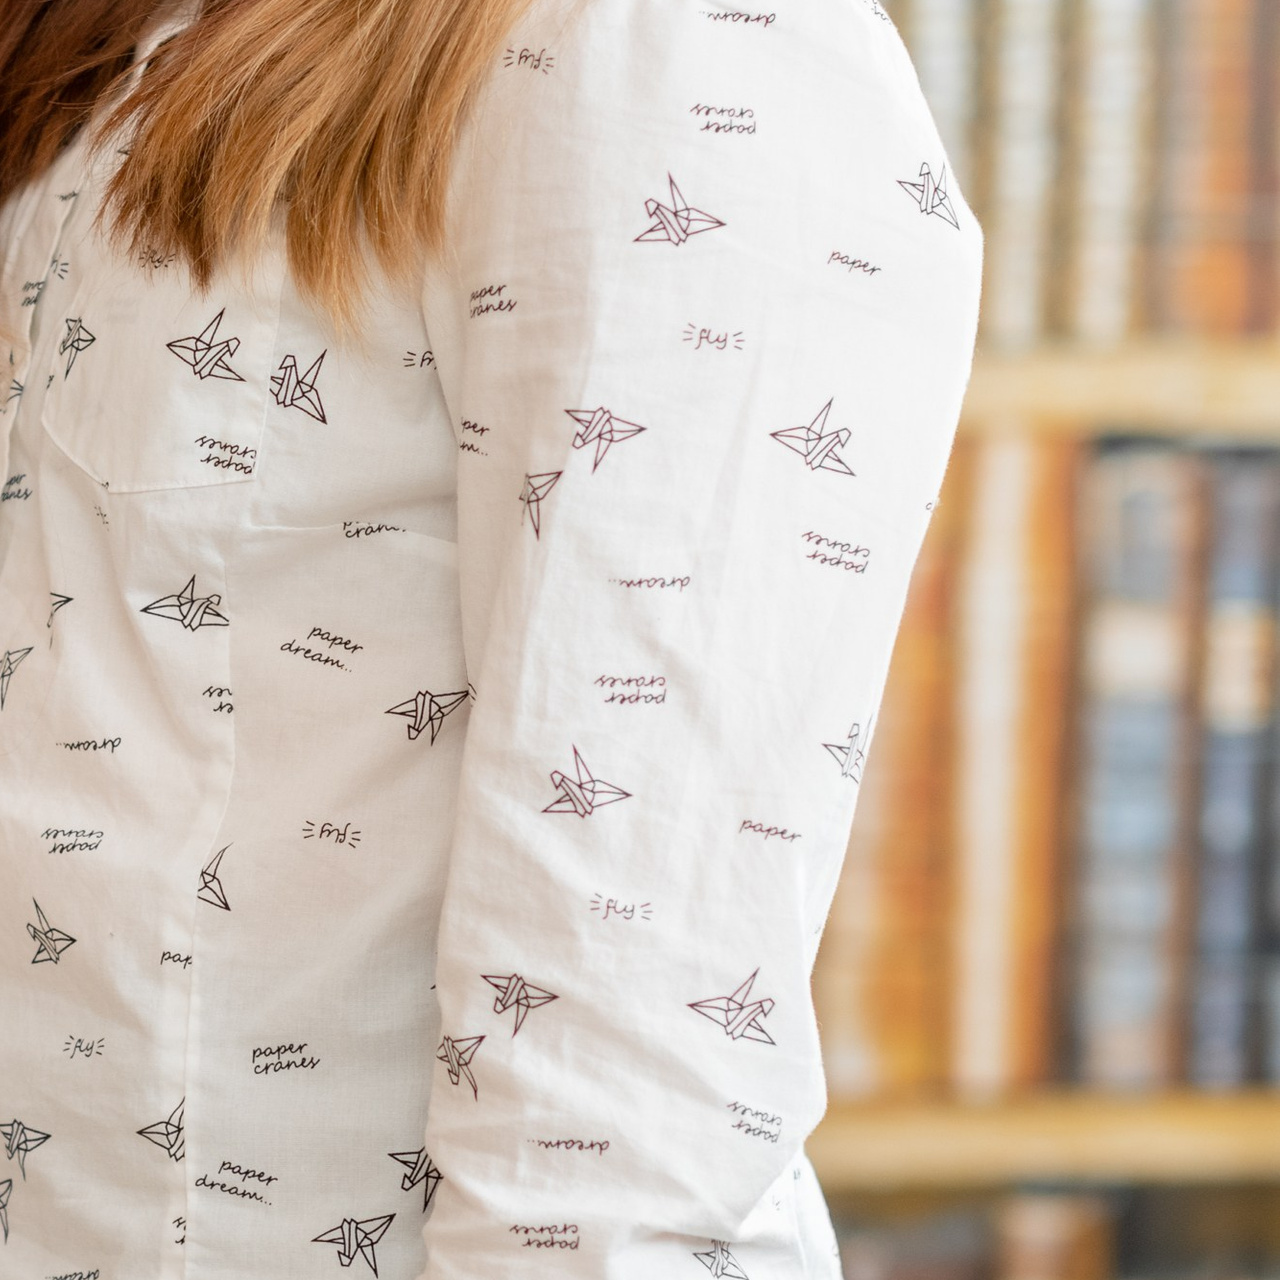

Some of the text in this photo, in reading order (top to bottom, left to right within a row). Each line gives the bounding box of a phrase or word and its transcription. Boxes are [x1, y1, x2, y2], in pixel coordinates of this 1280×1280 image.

[698, 11, 776, 28] dream...
[519, 48, 546, 70] fly
[689, 102, 755, 118] cranes
[700, 120, 757, 135] paper
[827, 250, 882, 276] paper
[695, 328, 728, 350] fly
[801, 531, 871, 558] cranes
[806, 552, 869, 574] paper
[608, 575, 691, 592] dream...
[306, 625, 364, 654] paper
[280, 639, 353, 673] dream...
[593, 674, 666, 689] cranes
[604, 690, 666, 705] paper
[55, 736, 121, 754] dream...
[41, 829, 104, 841] cranes
[320, 822, 351, 846] fly
[739, 818, 802, 842] paper
[48, 839, 102, 854] paper
[602, 898, 635, 920] fly
[70, 1036, 95, 1060] fly
[252, 1042, 308, 1065] paper
[253, 1058, 321, 1075] cranes
[726, 1101, 783, 1126] cranes
[731, 1121, 781, 1143] paper
[527, 1139, 610, 1156] dream...
[217, 1160, 279, 1186] paper
[194, 1174, 273, 1206] dream...
[509, 1222, 579, 1236] cranes
[522, 1236, 580, 1251] paper
